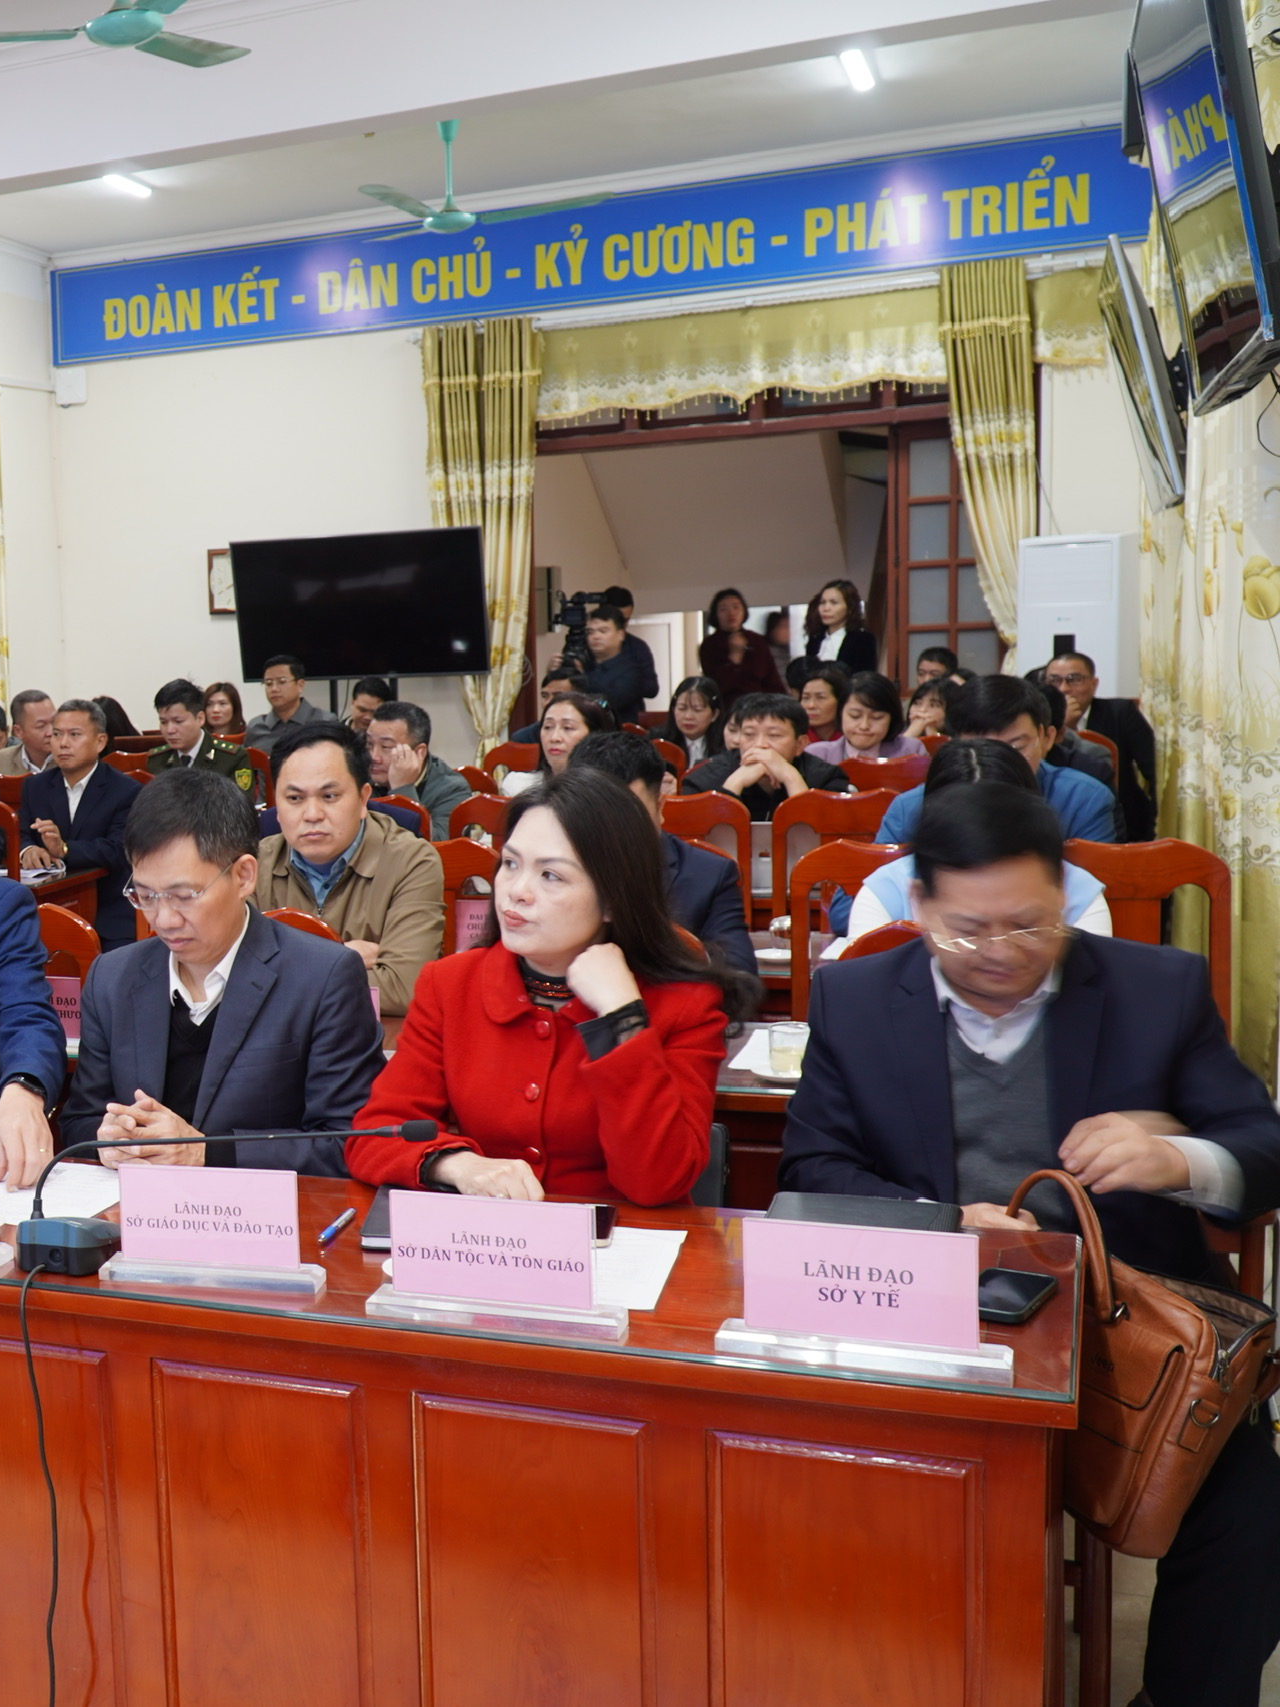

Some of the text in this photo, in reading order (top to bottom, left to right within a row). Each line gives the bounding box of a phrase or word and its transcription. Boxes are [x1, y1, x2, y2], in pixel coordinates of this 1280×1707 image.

[103, 283, 202, 341] ĐOÀN
[213, 266, 280, 328] KẾT
[318, 258, 398, 316] DÂN
[411, 236, 492, 304] CHỦ
[535, 223, 589, 289] KỶ
[602, 217, 755, 281] CƯƠNG
[804, 187, 930, 258] PHÁT
[942, 155, 1091, 240] TRIỂN
[174, 1201, 242, 1218] LÃNH ĐẠO
[126, 1214, 293, 1238] SỞ GIÁO DỤC VÀ ĐÀO TẠO
[451, 1231, 527, 1251] LÃNH ĐẠO
[398, 1243, 585, 1273] SỞ DÂN TỘC VÀ TÔN GIÁO
[803, 1259, 914, 1287] LÃNH ĐẠO
[818, 1283, 900, 1309] SỞ Y TẾ
